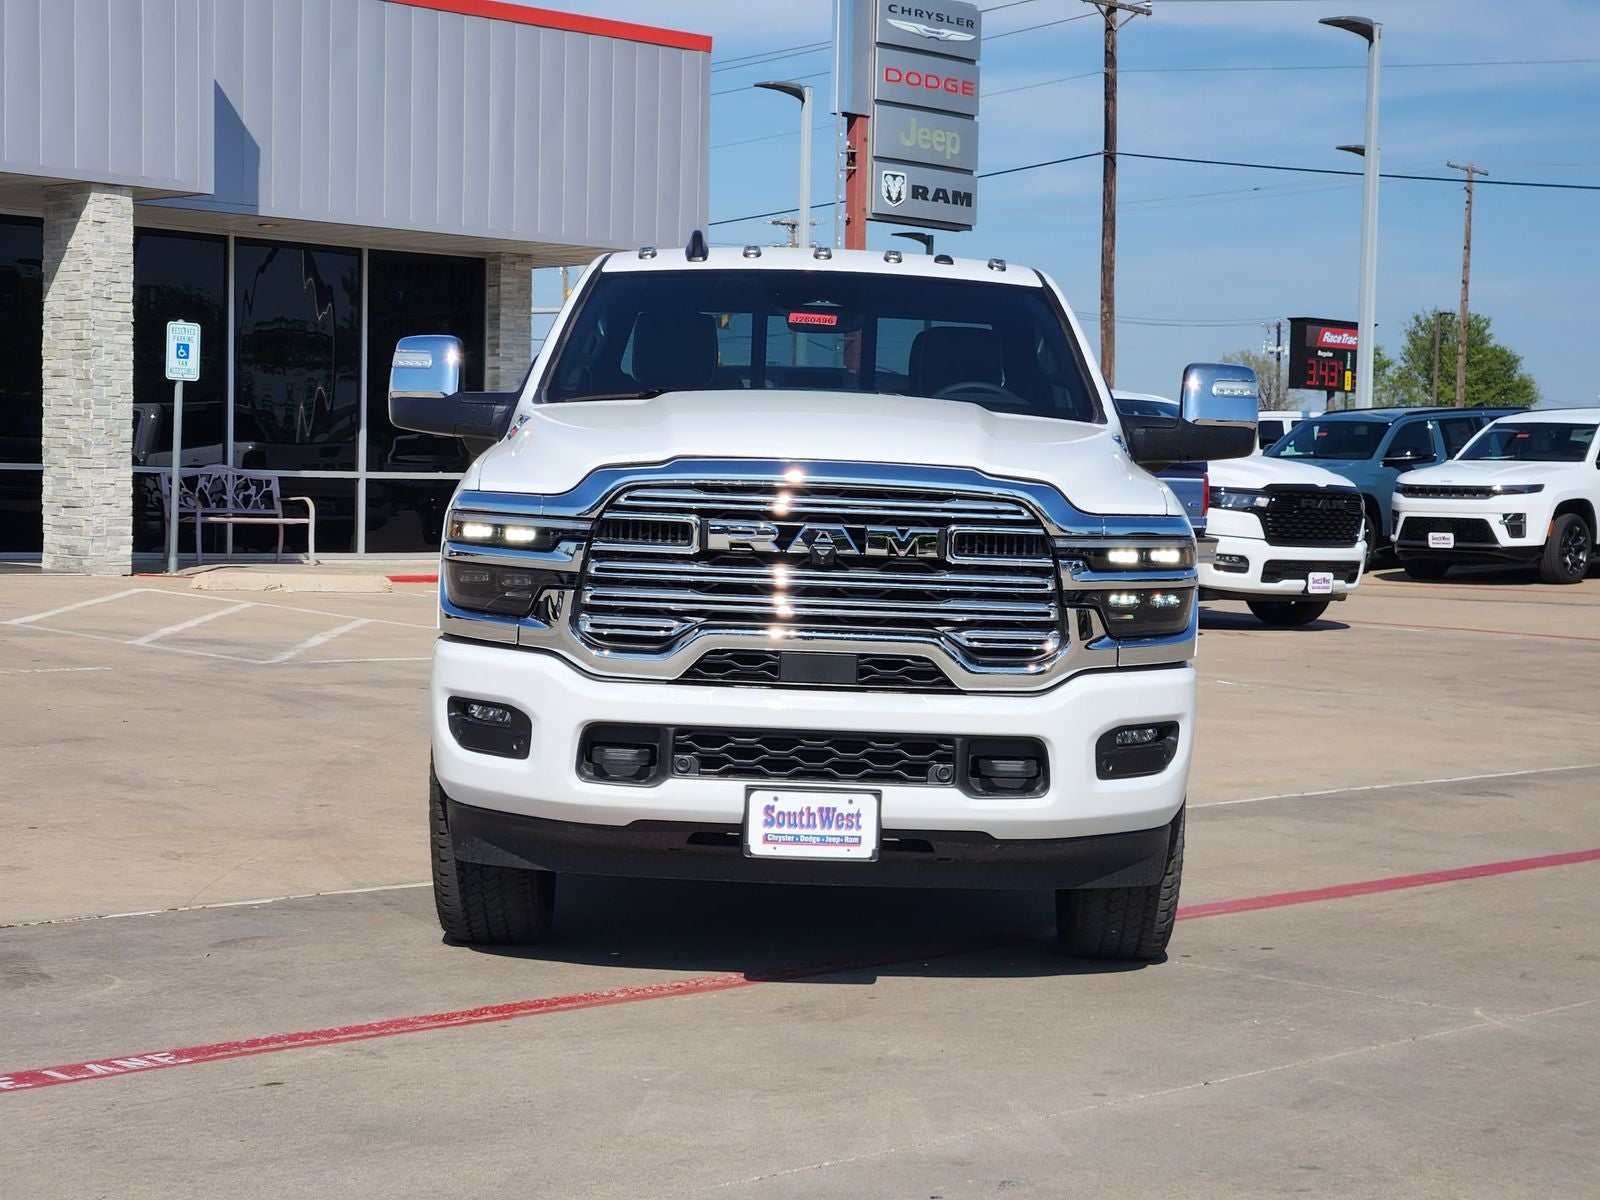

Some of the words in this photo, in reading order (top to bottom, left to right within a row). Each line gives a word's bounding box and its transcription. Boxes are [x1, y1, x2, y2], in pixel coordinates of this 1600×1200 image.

[888, 4, 975, 29] CHRYSLER
[884, 67, 974, 97] DODGE
[899, 117, 961, 159] Jeep
[911, 184, 972, 207] RAM
[171, 326, 196, 336] RESERVED
[792, 316, 834, 325] J260496
[707, 519, 940, 559] RAM
[767, 833, 795, 843] Chrysler
[800, 835, 820, 843] Dodge
[825, 836, 840, 845] Jeep
[844, 836, 859, 844] Ram
[40, 1052, 193, 1080] LANE
